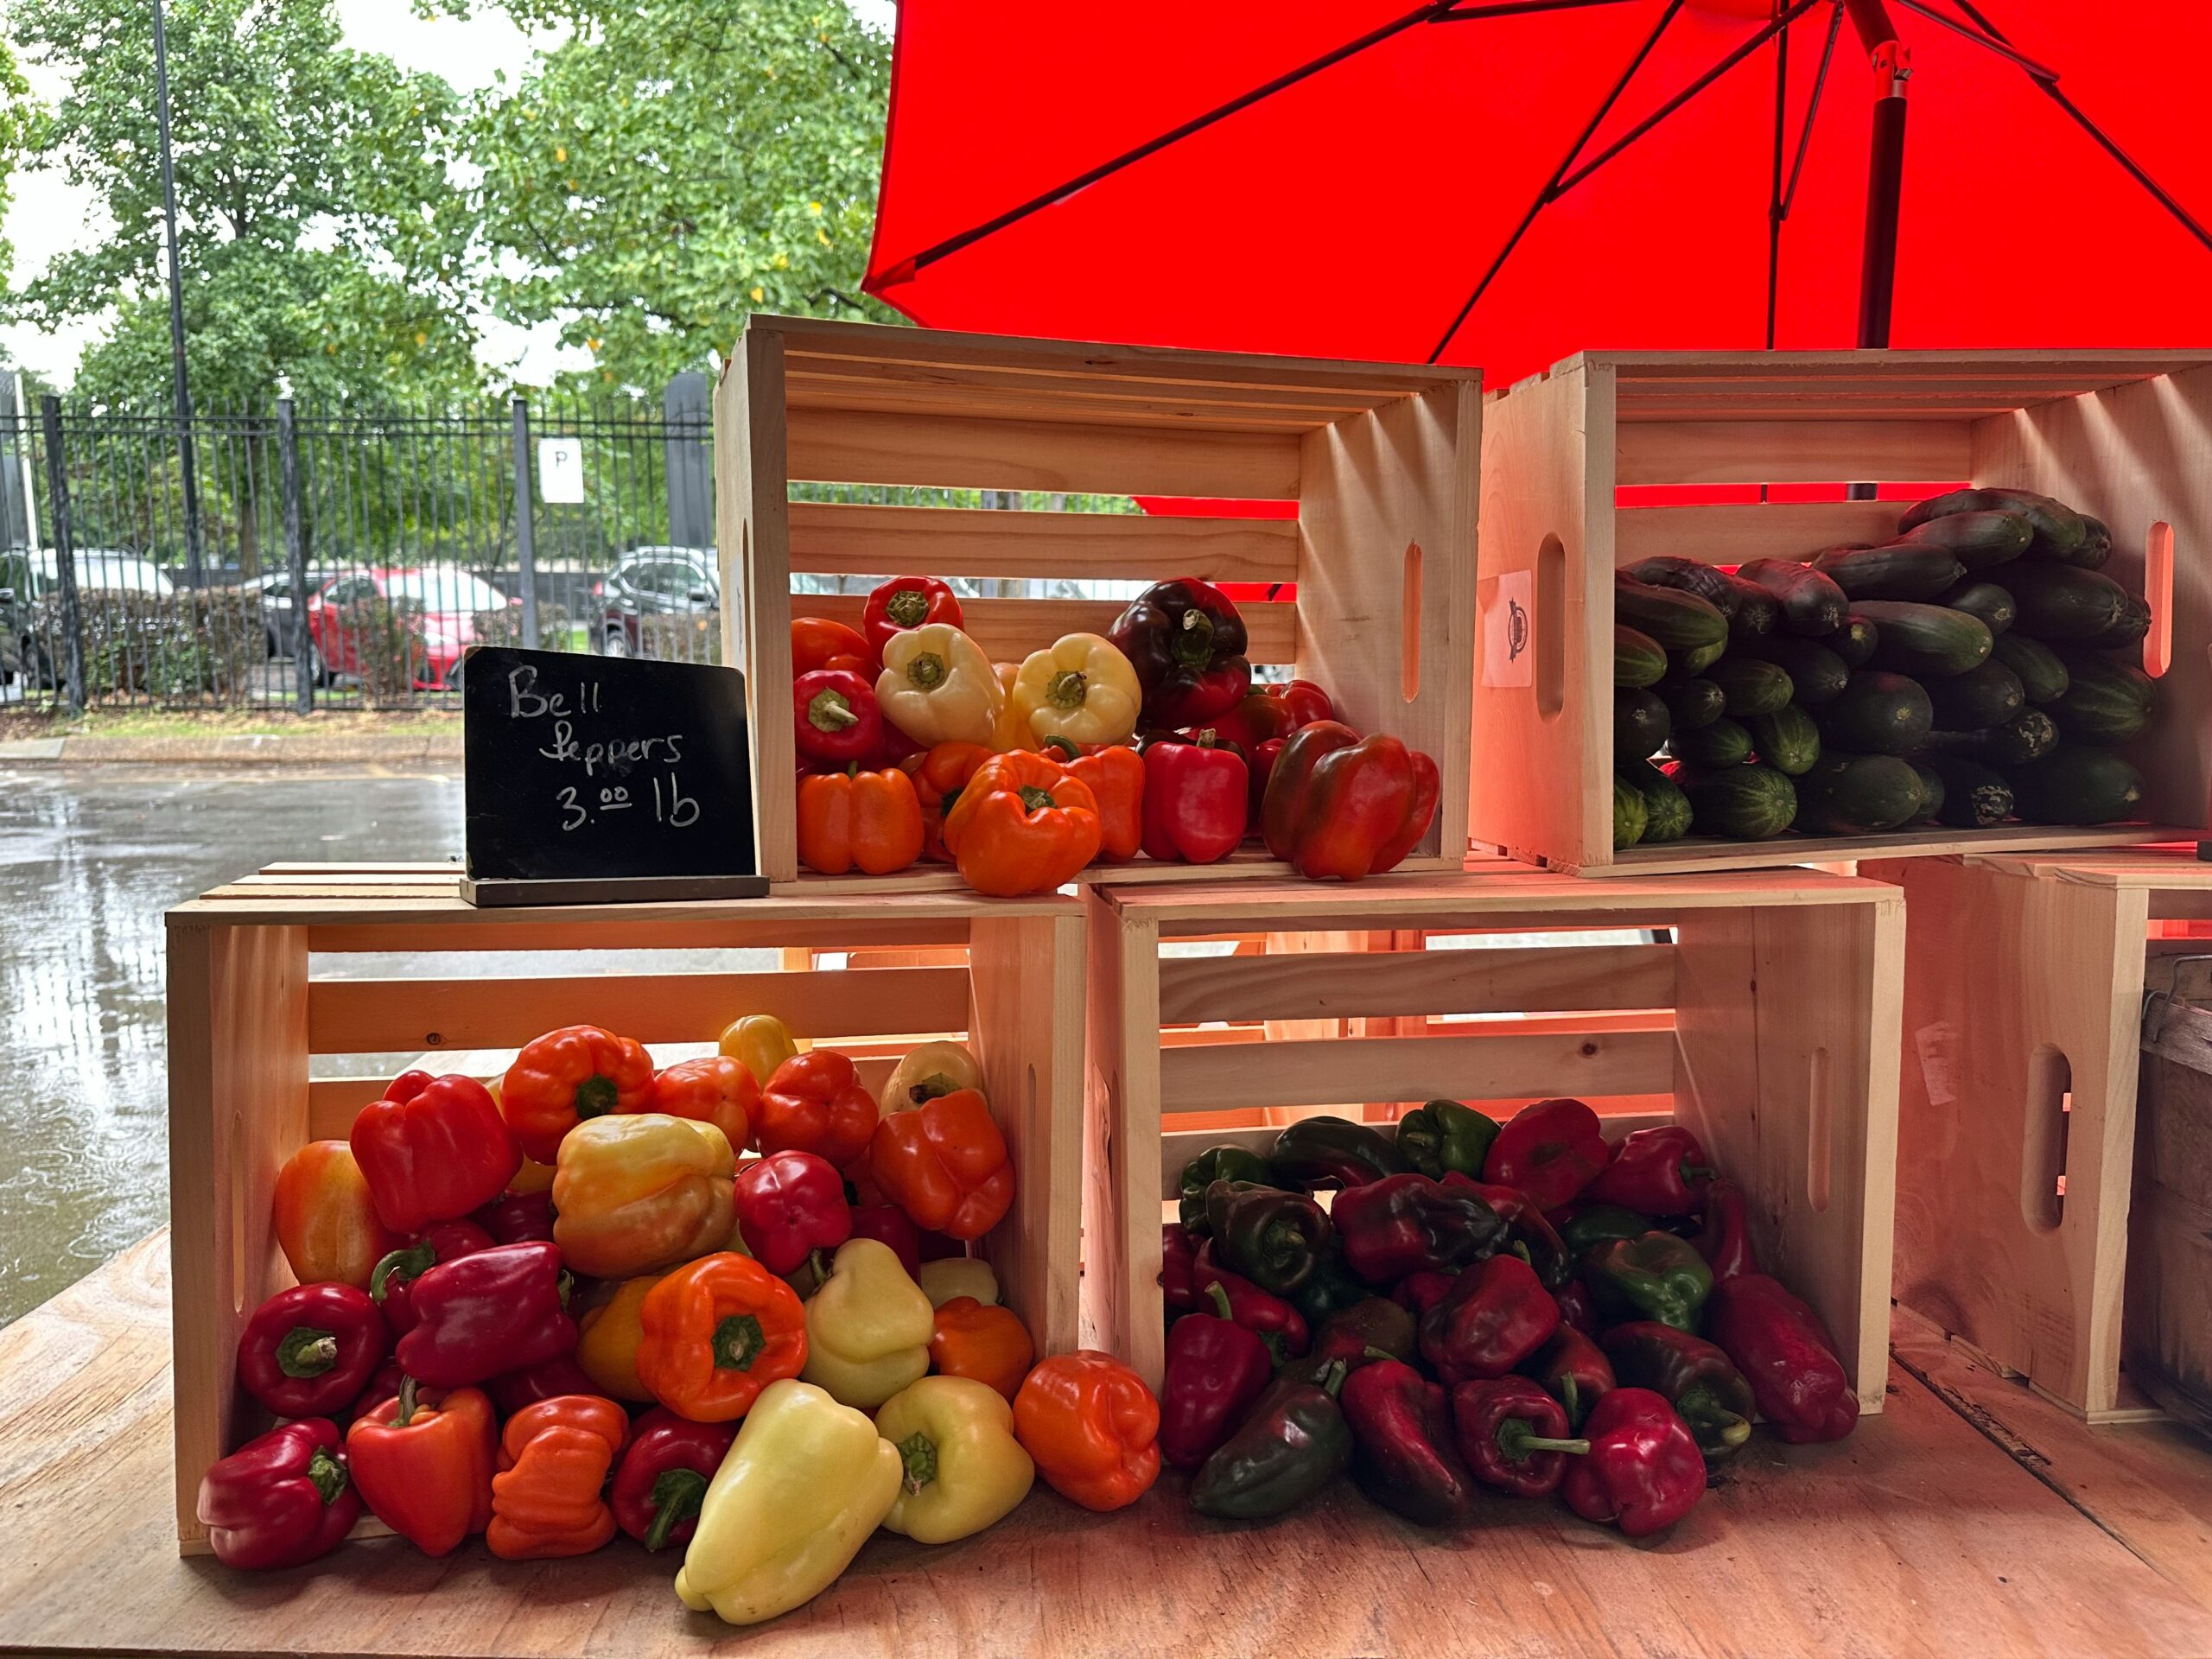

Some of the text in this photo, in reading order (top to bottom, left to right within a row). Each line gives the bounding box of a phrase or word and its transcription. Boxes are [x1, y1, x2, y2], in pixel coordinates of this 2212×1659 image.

[555, 450, 568, 467] P
[508, 665, 599, 719] Bell
[539, 720, 683, 776] Peppers
[556, 772, 700, 831] 3.00 lb
